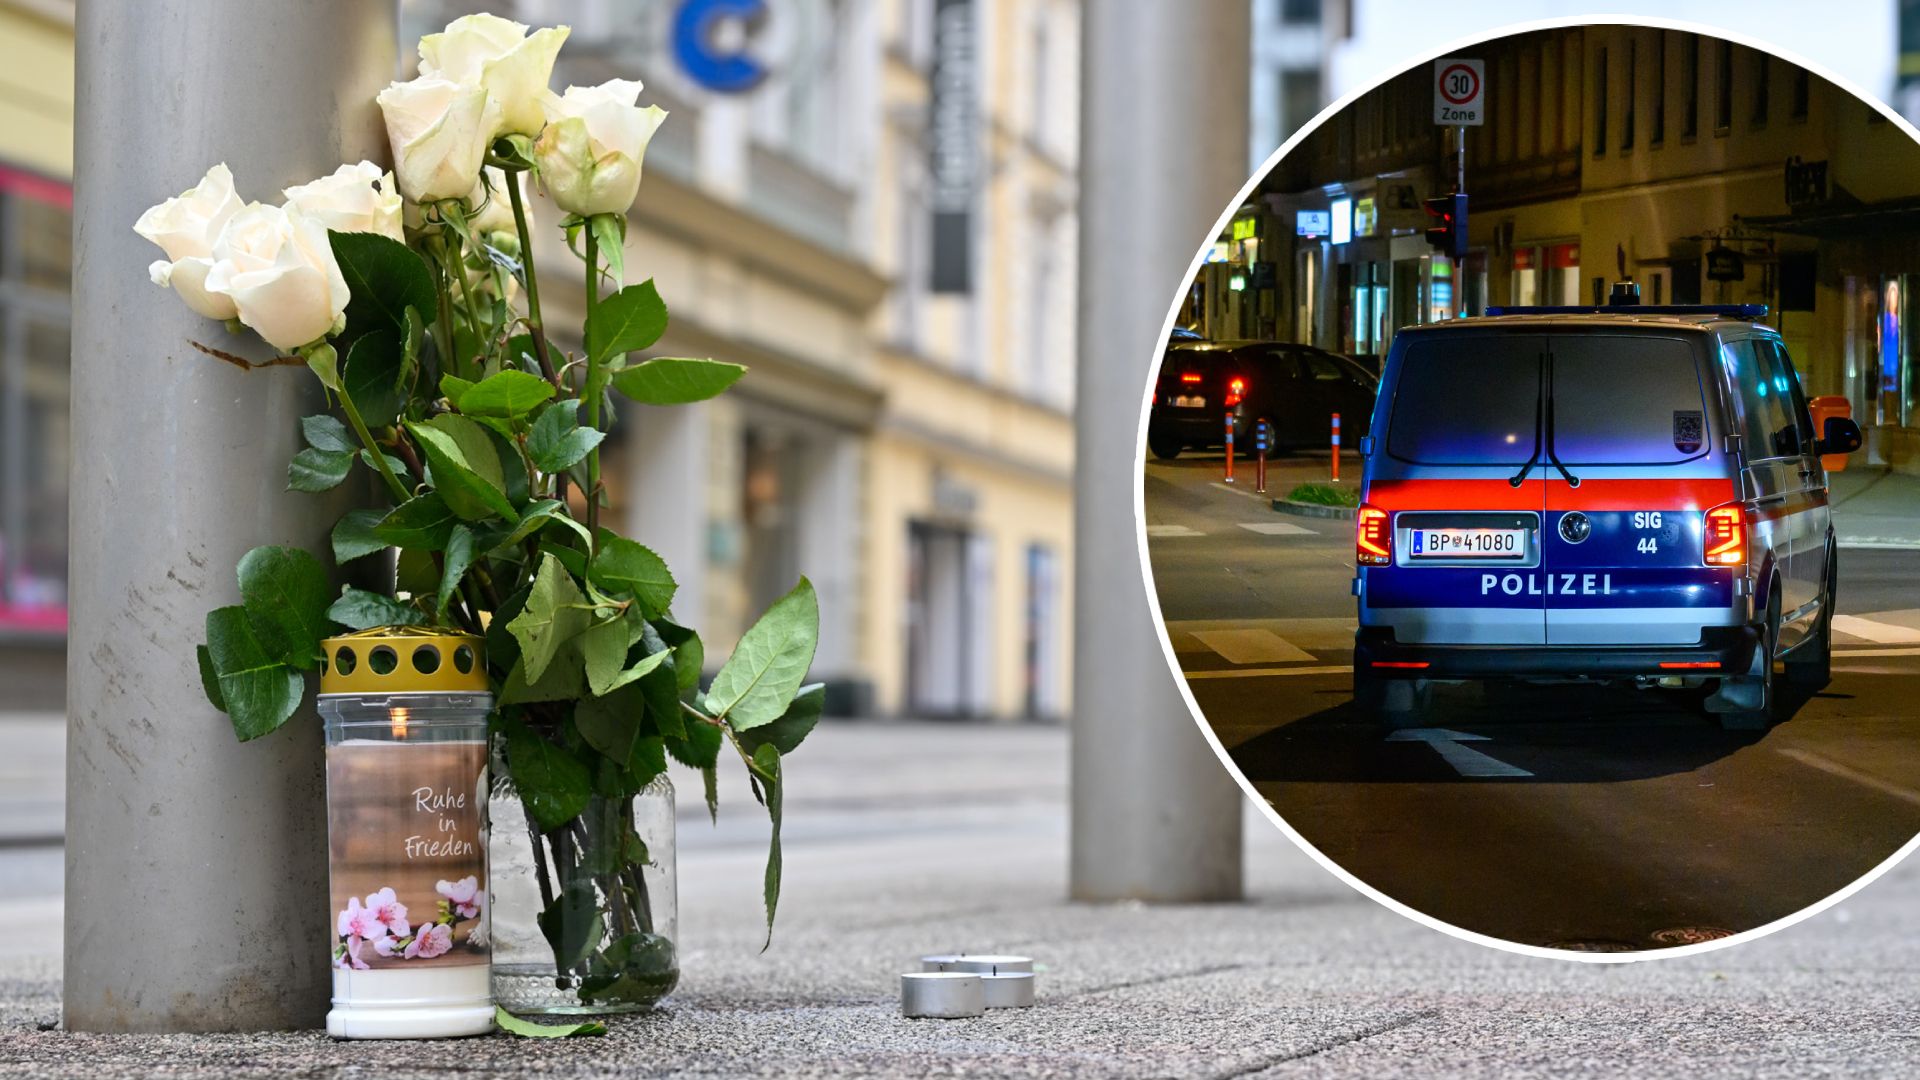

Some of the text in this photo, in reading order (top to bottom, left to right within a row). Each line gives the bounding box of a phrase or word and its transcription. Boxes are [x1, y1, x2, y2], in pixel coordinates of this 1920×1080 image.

[1450, 75, 1469, 94] 30
[1442, 107, 1476, 121] Zone
[1634, 511, 1662, 529] SIG
[1637, 537, 1658, 554] 44
[1481, 573, 1611, 595] POLIZEI
[411, 786, 465, 813] Ruhe
[438, 813, 457, 832] in
[404, 834, 473, 859] Frieden
